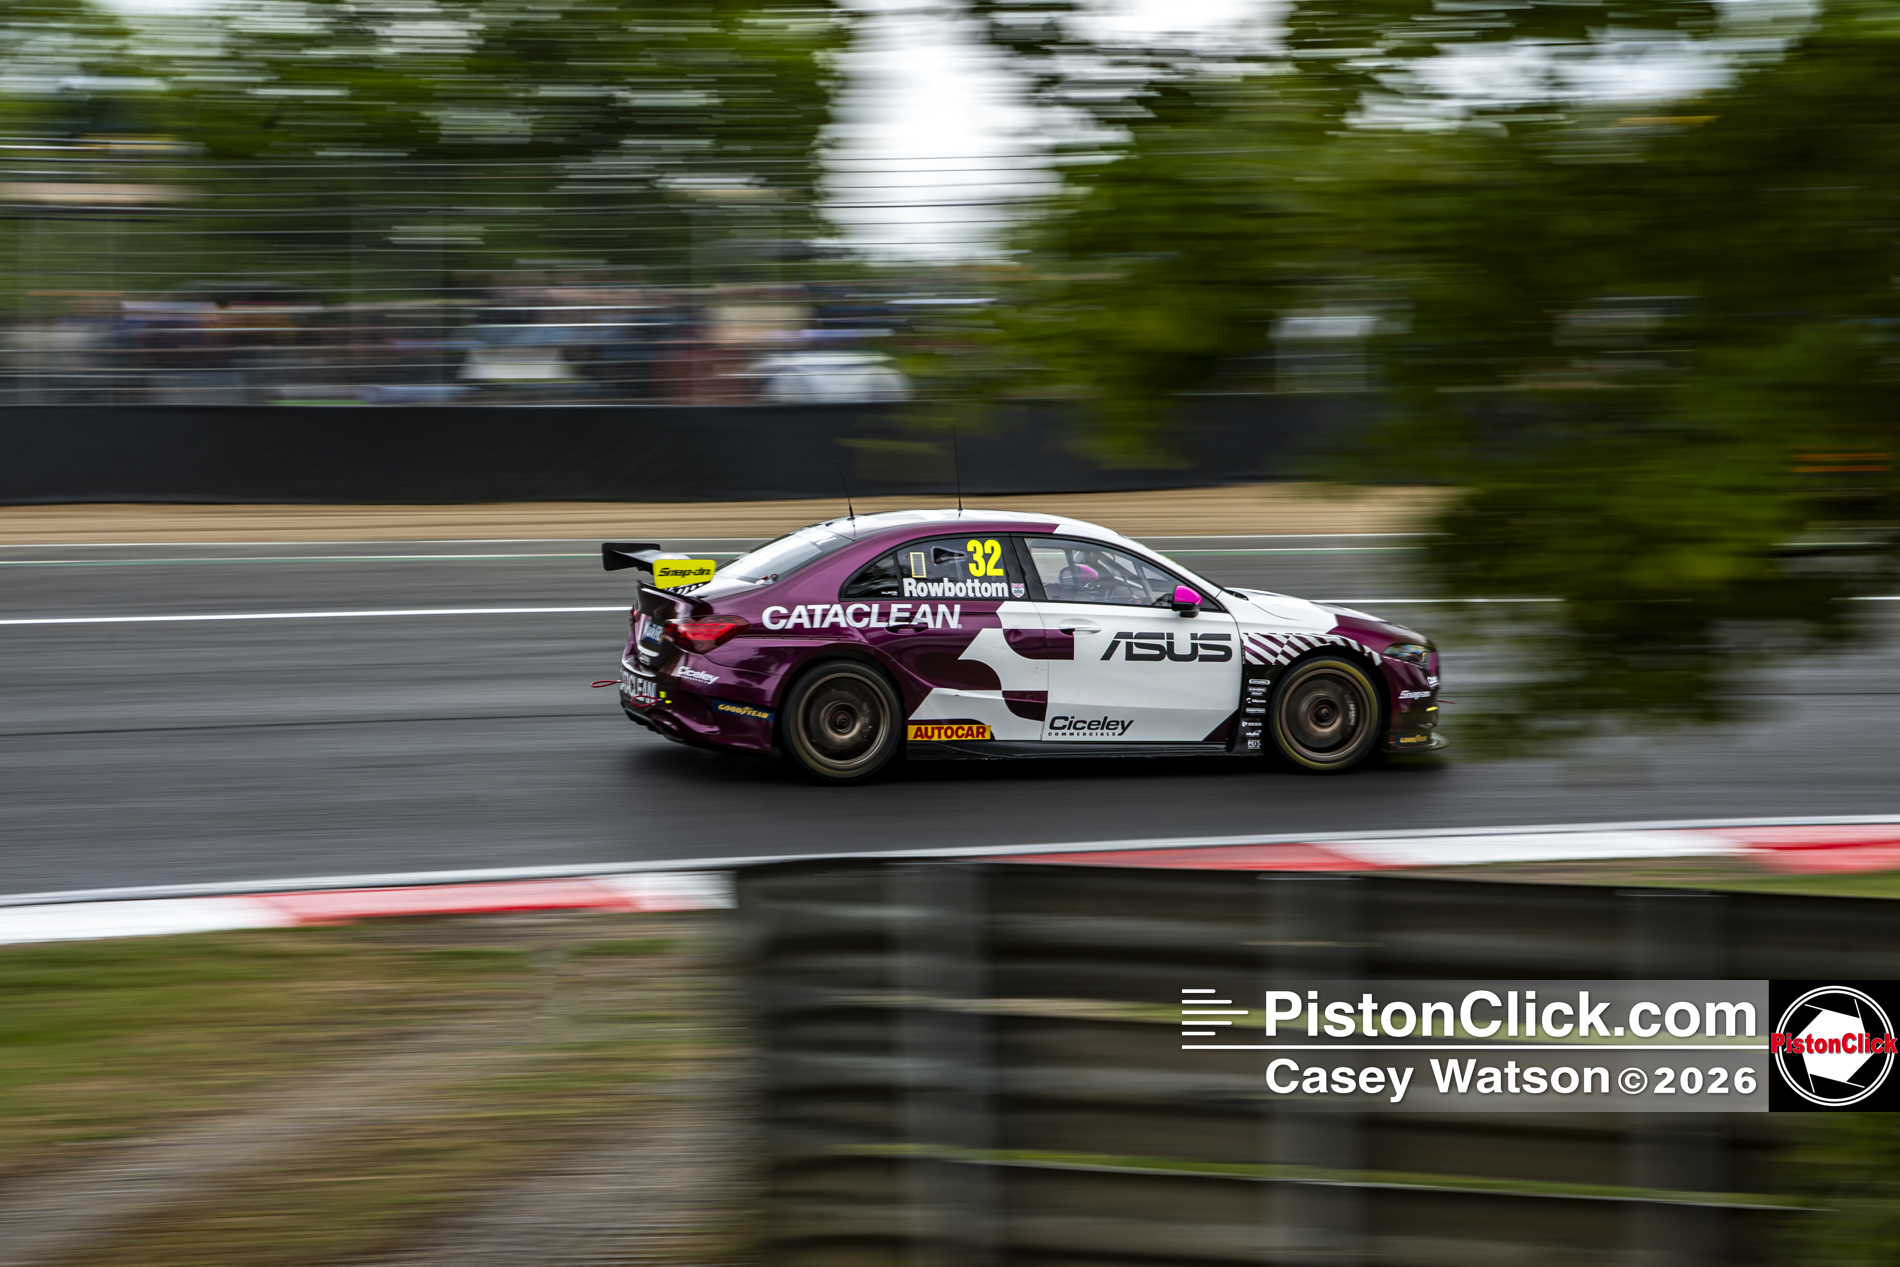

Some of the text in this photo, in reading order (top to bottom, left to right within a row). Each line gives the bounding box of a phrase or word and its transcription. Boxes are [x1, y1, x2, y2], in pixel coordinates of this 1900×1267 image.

[966, 539, 1004, 577] 32
[903, 577, 1009, 598] Rowbottom
[1100, 631, 1233, 663] ASUS
[677, 666, 719, 684] Ciceley
[718, 703, 769, 719] GOODYEAR
[912, 726, 987, 740] AUTOCAR
[1048, 715, 1134, 736] Ciceley
